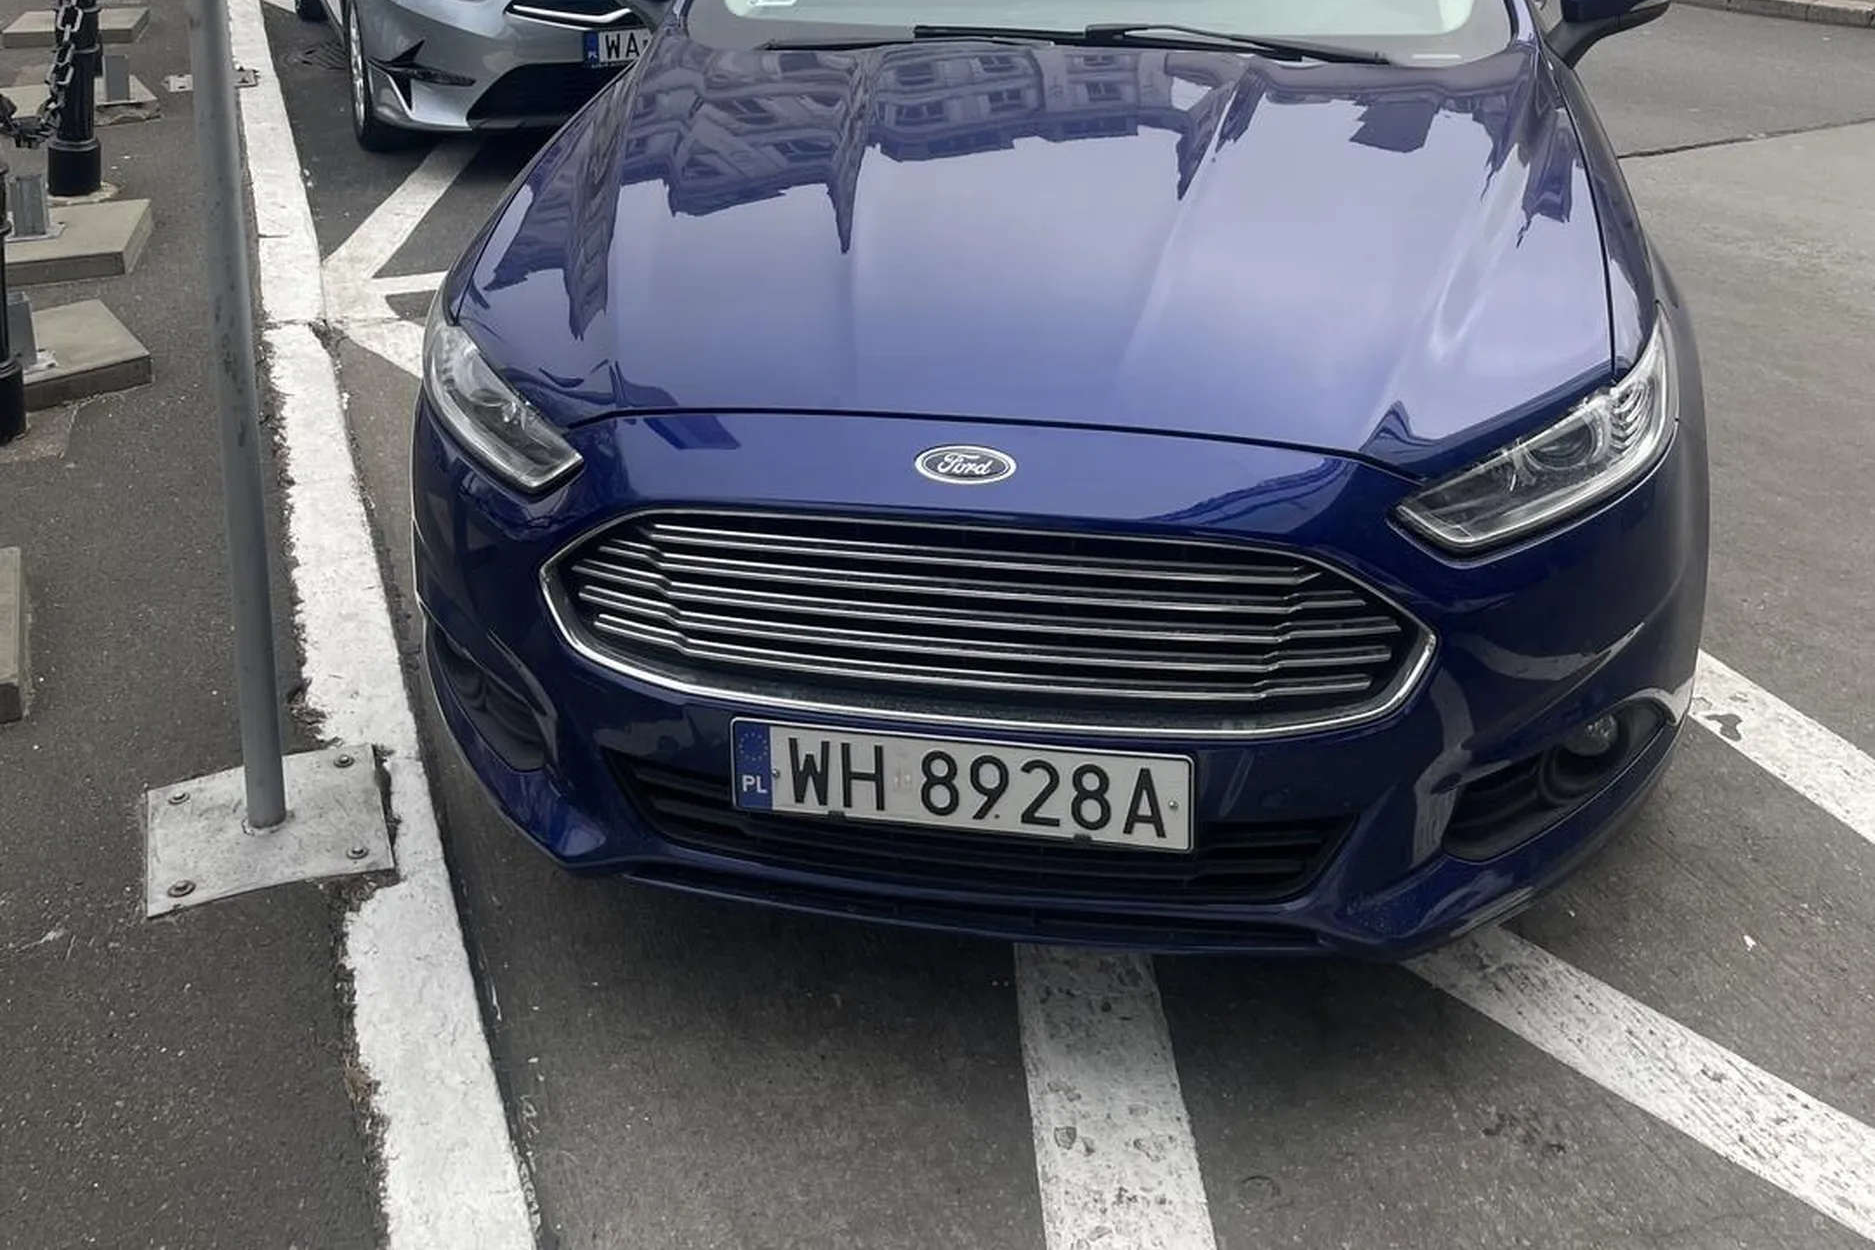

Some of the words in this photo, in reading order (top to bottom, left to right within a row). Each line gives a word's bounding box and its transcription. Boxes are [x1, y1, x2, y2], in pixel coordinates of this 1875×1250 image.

[605, 32, 640, 59] WA
[937, 452, 993, 475] Ford
[742, 775, 767, 794] PL
[788, 737, 885, 811] WH
[921, 750, 1168, 839] 8928A
